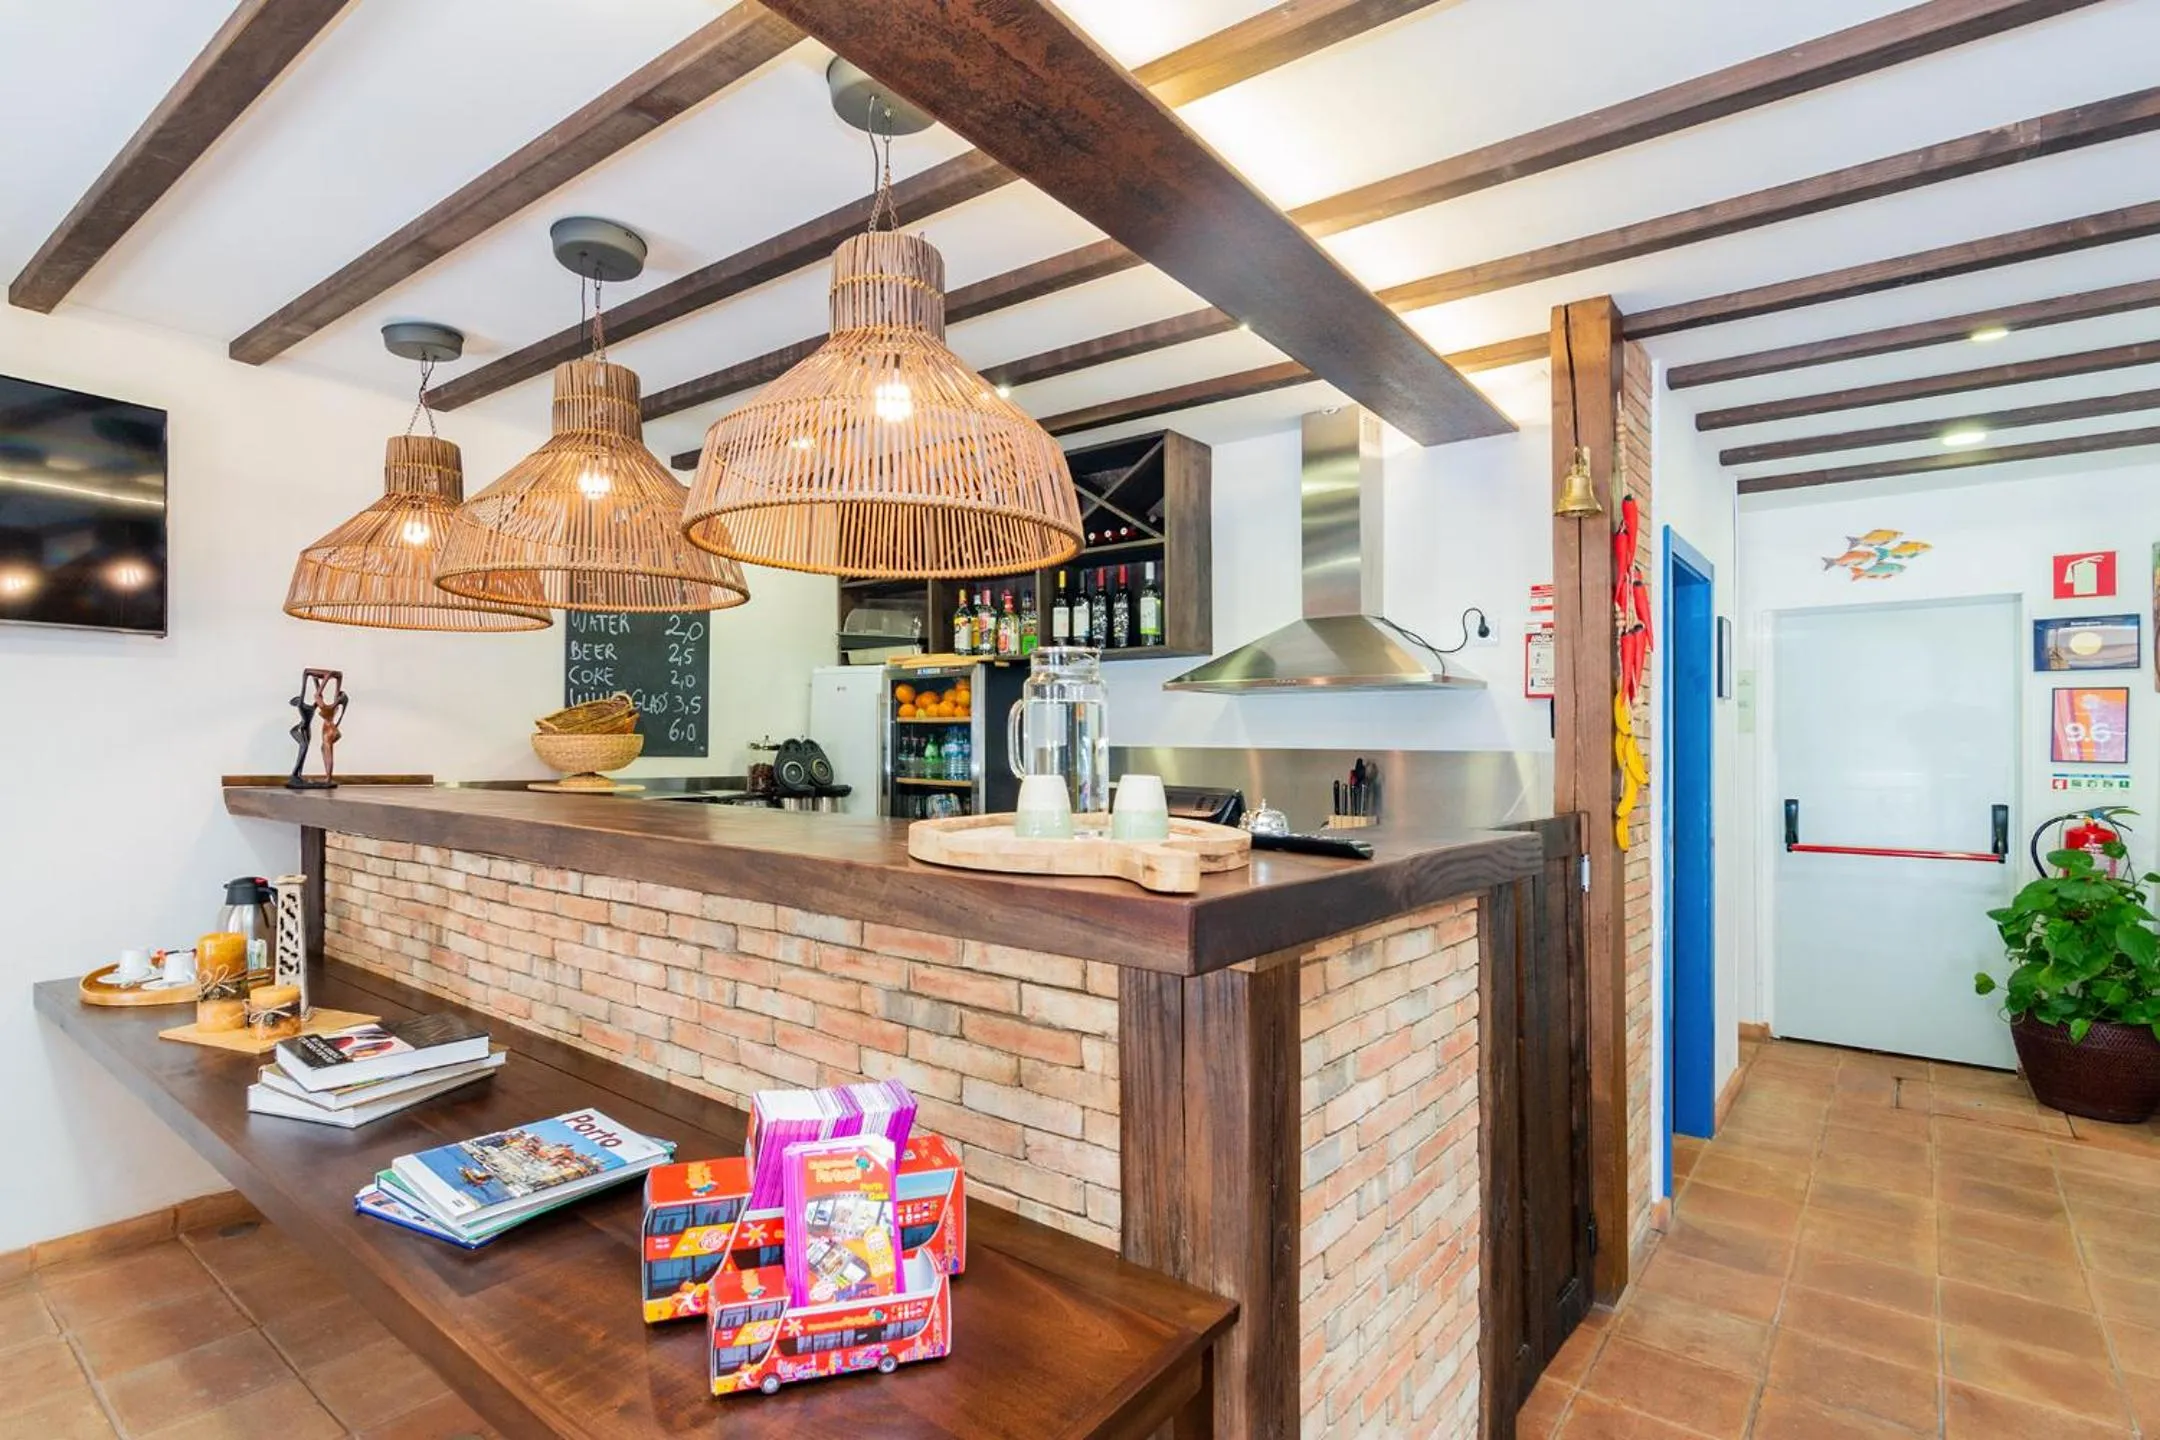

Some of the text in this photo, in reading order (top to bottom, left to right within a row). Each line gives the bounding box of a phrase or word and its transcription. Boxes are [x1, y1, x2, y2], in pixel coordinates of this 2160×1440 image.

[571, 612, 631, 635] WATER
[569, 640, 695, 666] BEER 2,5
[568, 665, 696, 690] COKE 2,0
[672, 694, 702, 715] 3,5
[668, 718, 697, 742] 6,0
[2065, 722, 2111, 743] 9.6
[562, 1114, 623, 1147] Porto
